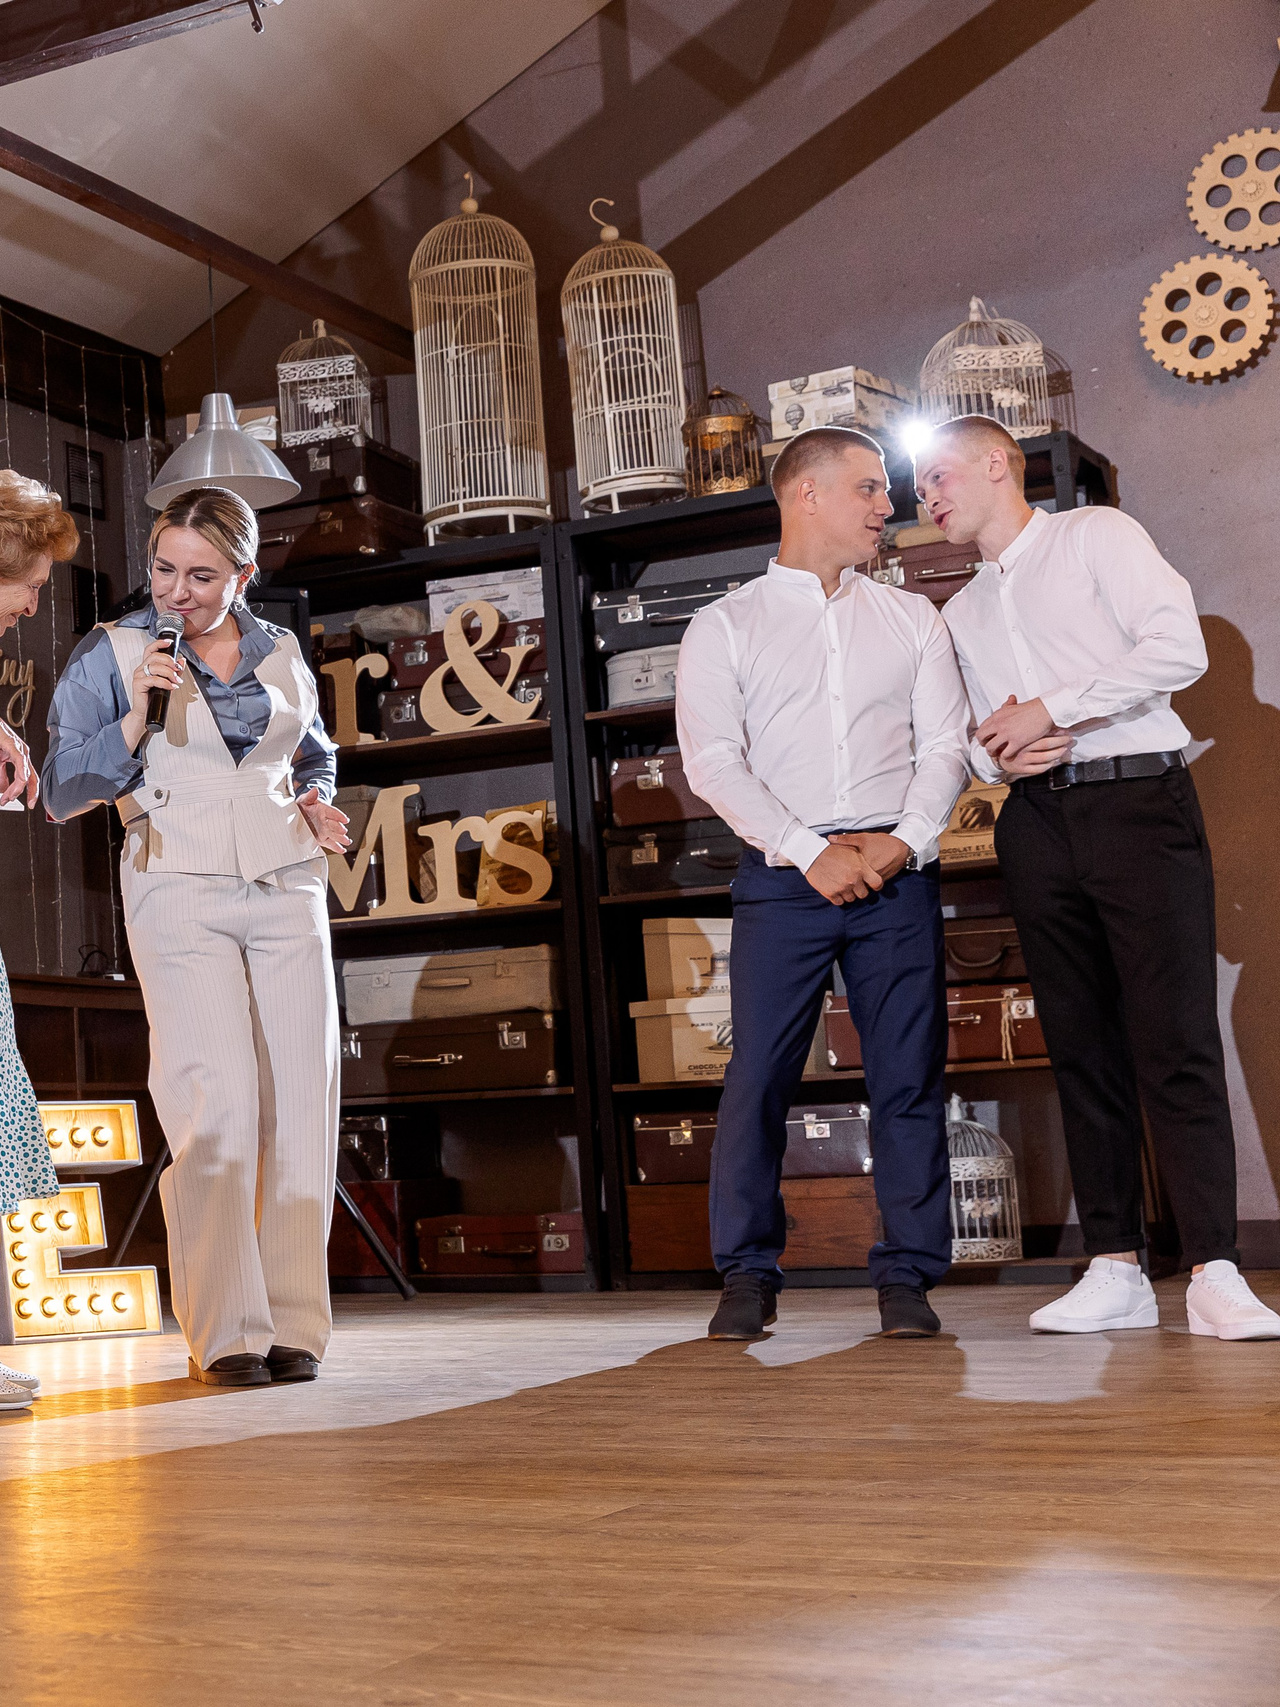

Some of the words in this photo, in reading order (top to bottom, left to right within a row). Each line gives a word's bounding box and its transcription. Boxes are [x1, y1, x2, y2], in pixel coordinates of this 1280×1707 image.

[310, 623, 389, 746] r
[420, 600, 542, 734] &
[328, 784, 553, 916] Mrs
